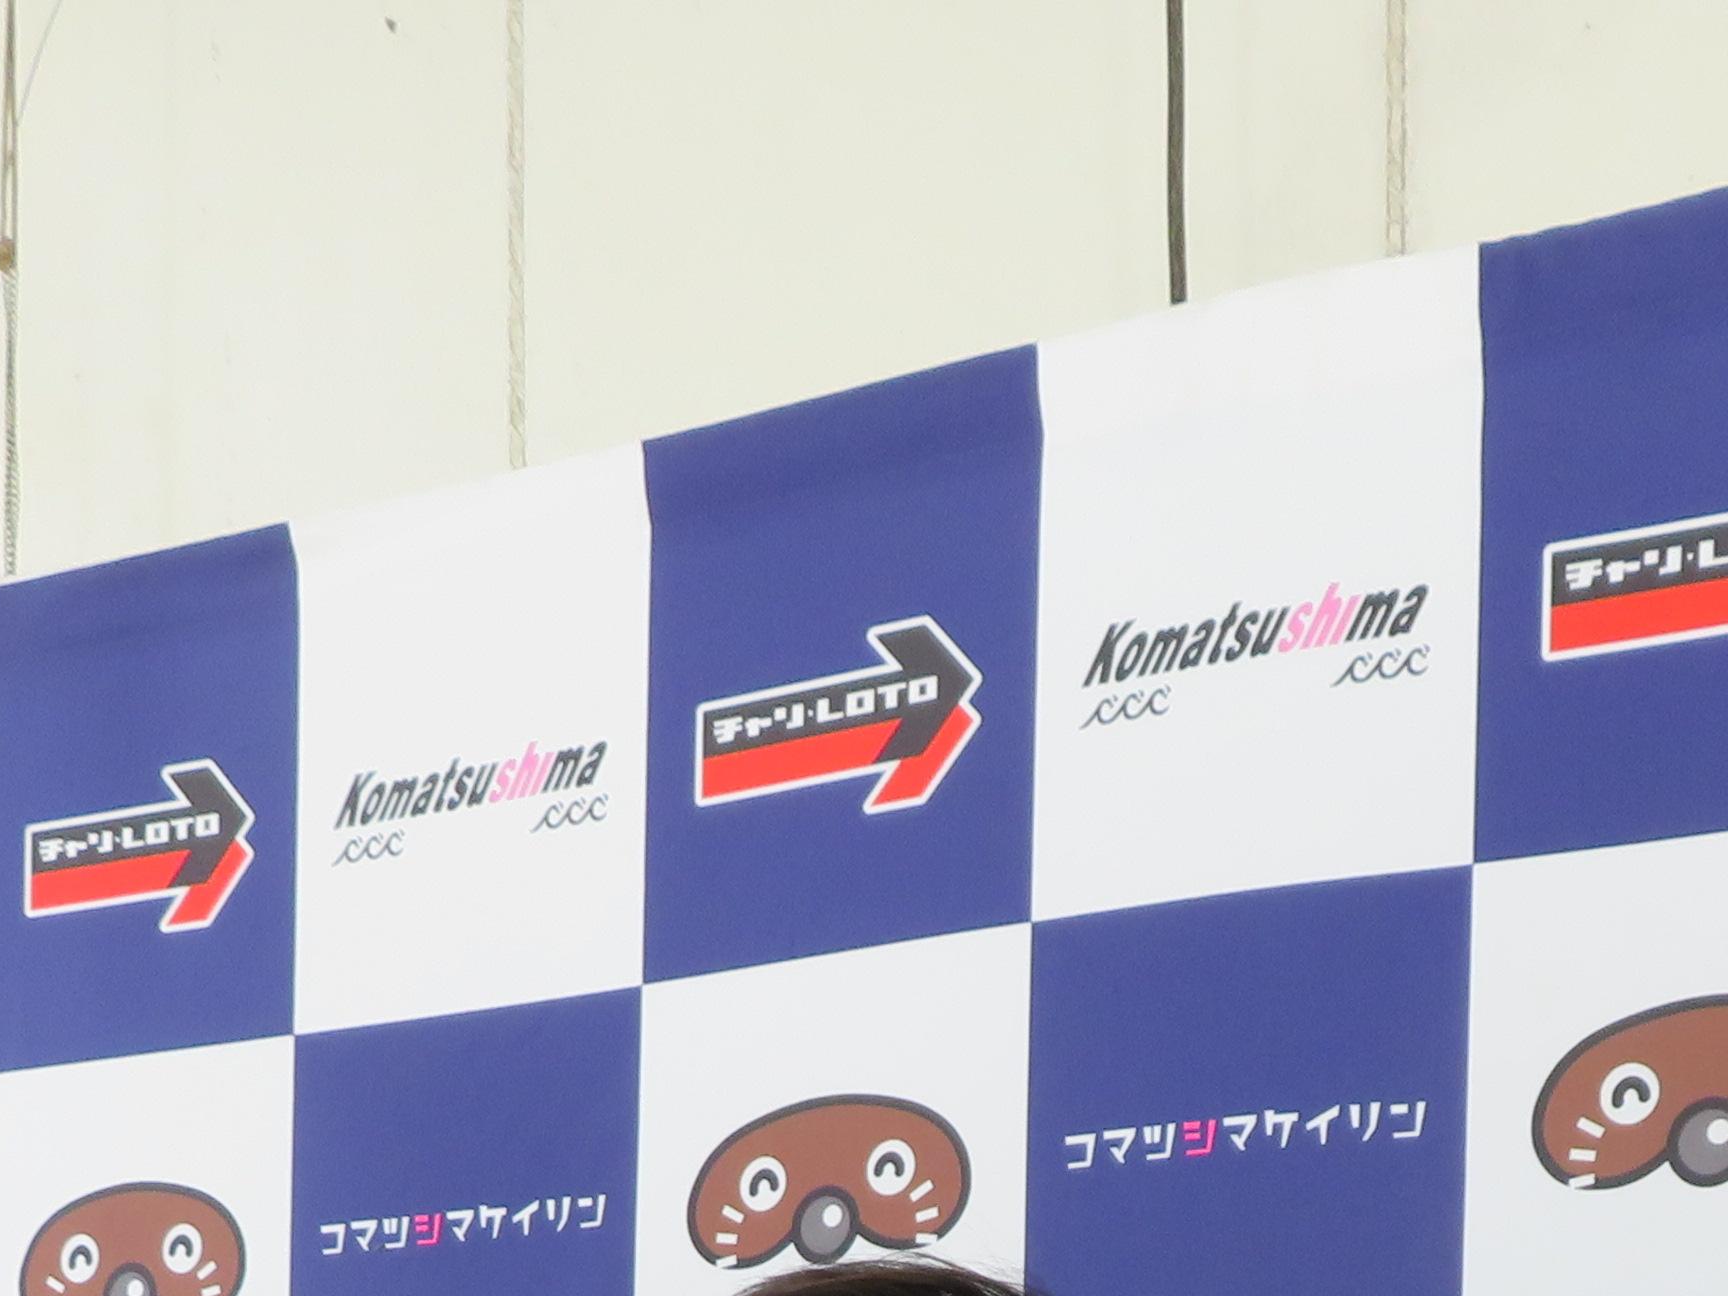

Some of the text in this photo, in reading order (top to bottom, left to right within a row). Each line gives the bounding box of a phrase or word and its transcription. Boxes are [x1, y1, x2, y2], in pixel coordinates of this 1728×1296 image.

[1083, 586, 1428, 686] Komatsushima
[338, 741, 606, 827] Komatsushima
[1064, 1101, 1427, 1170] コマツシマケイリン
[319, 1194, 607, 1256] コマツシマケイリン
